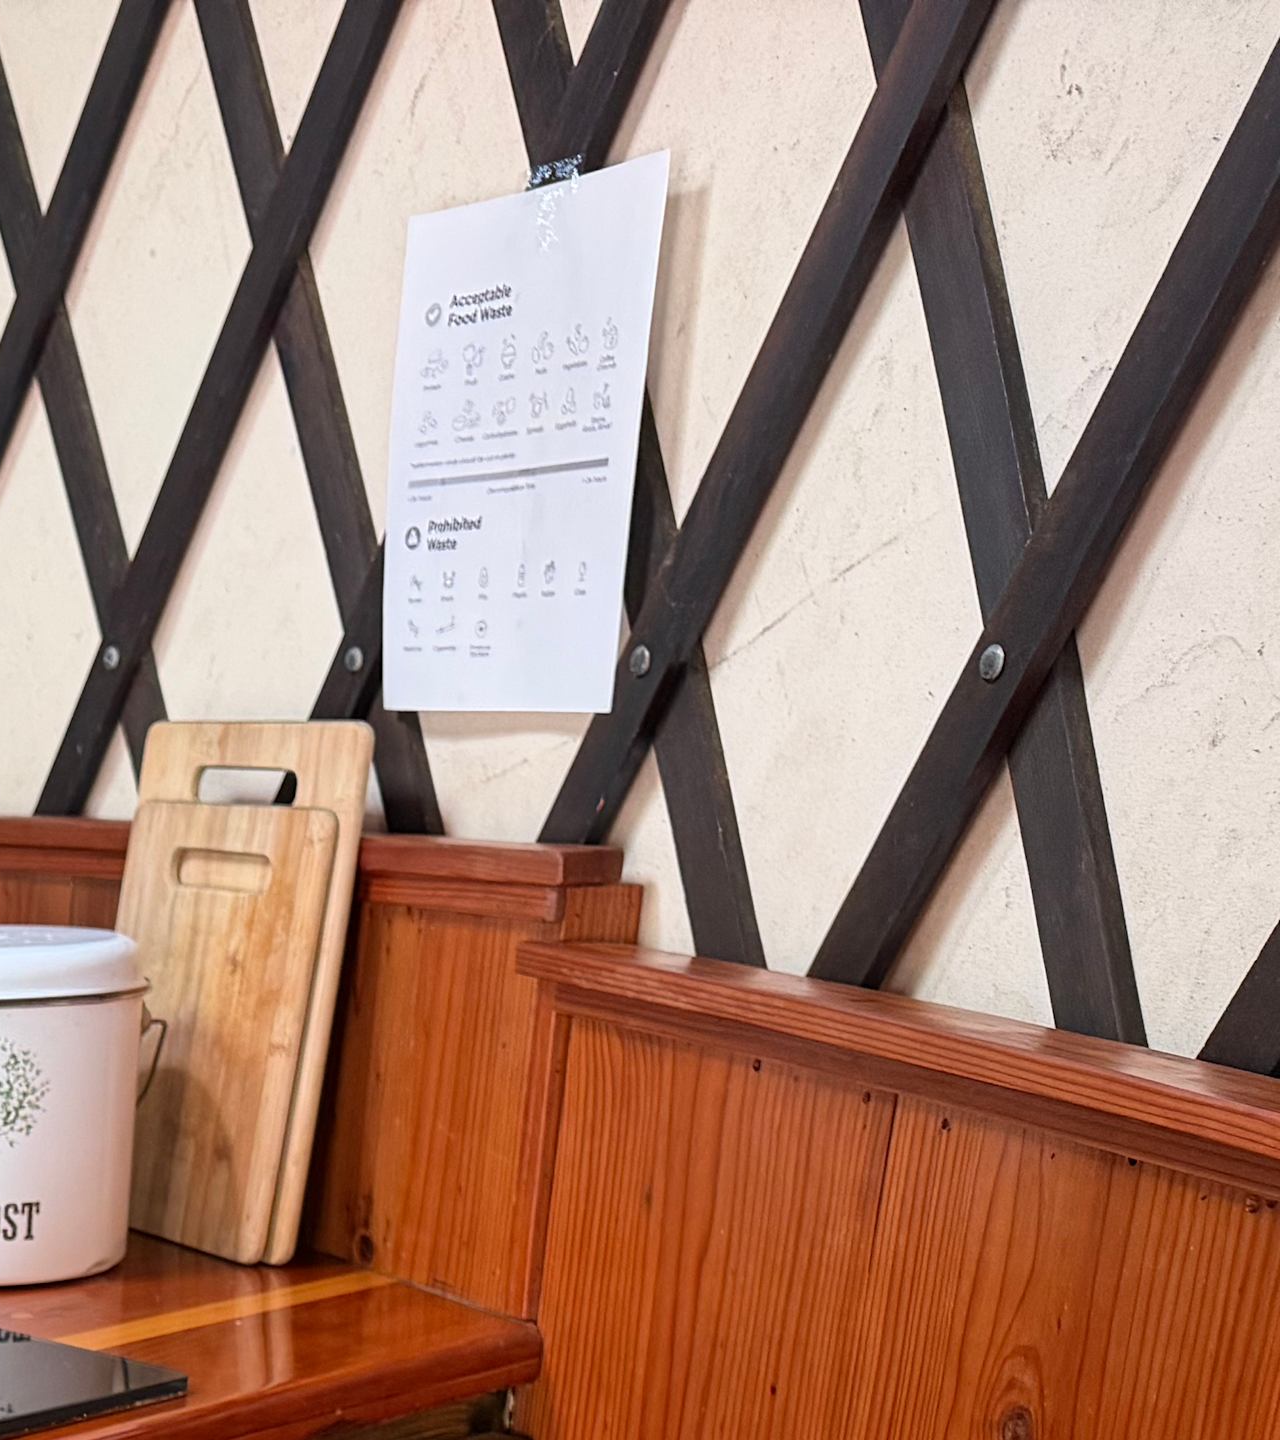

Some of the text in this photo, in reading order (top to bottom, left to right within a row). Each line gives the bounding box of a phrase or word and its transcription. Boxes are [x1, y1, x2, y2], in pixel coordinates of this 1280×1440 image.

[449, 284, 512, 308] Acceptable
[447, 304, 513, 327] Food Waste
[428, 516, 482, 534] Prohibited
[427, 539, 457, 551] Waste
